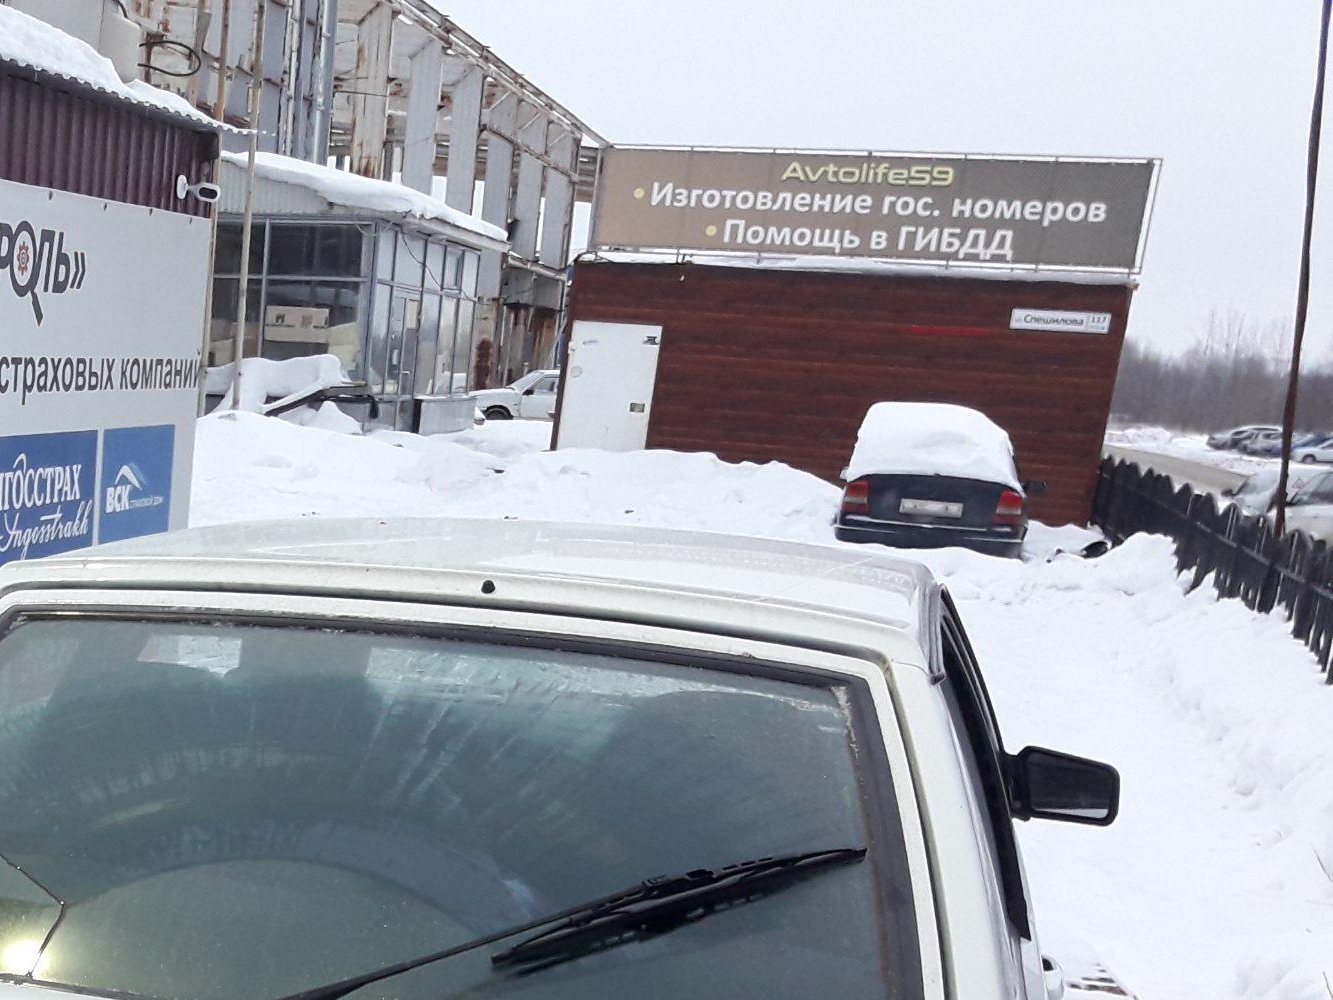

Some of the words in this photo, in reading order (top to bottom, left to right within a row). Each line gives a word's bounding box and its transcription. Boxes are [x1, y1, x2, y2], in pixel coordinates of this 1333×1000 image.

[780, 162, 954, 187] Avtolife59
[650, 181, 872, 214] Изготовление
[881, 195, 940, 217] гос.
[952, 197, 1108, 227] номеров
[722, 218, 861, 253] Помощь
[869, 230, 888, 250] в
[897, 225, 1014, 261] ГИБДД
[105, 484, 132, 513] ВСК
